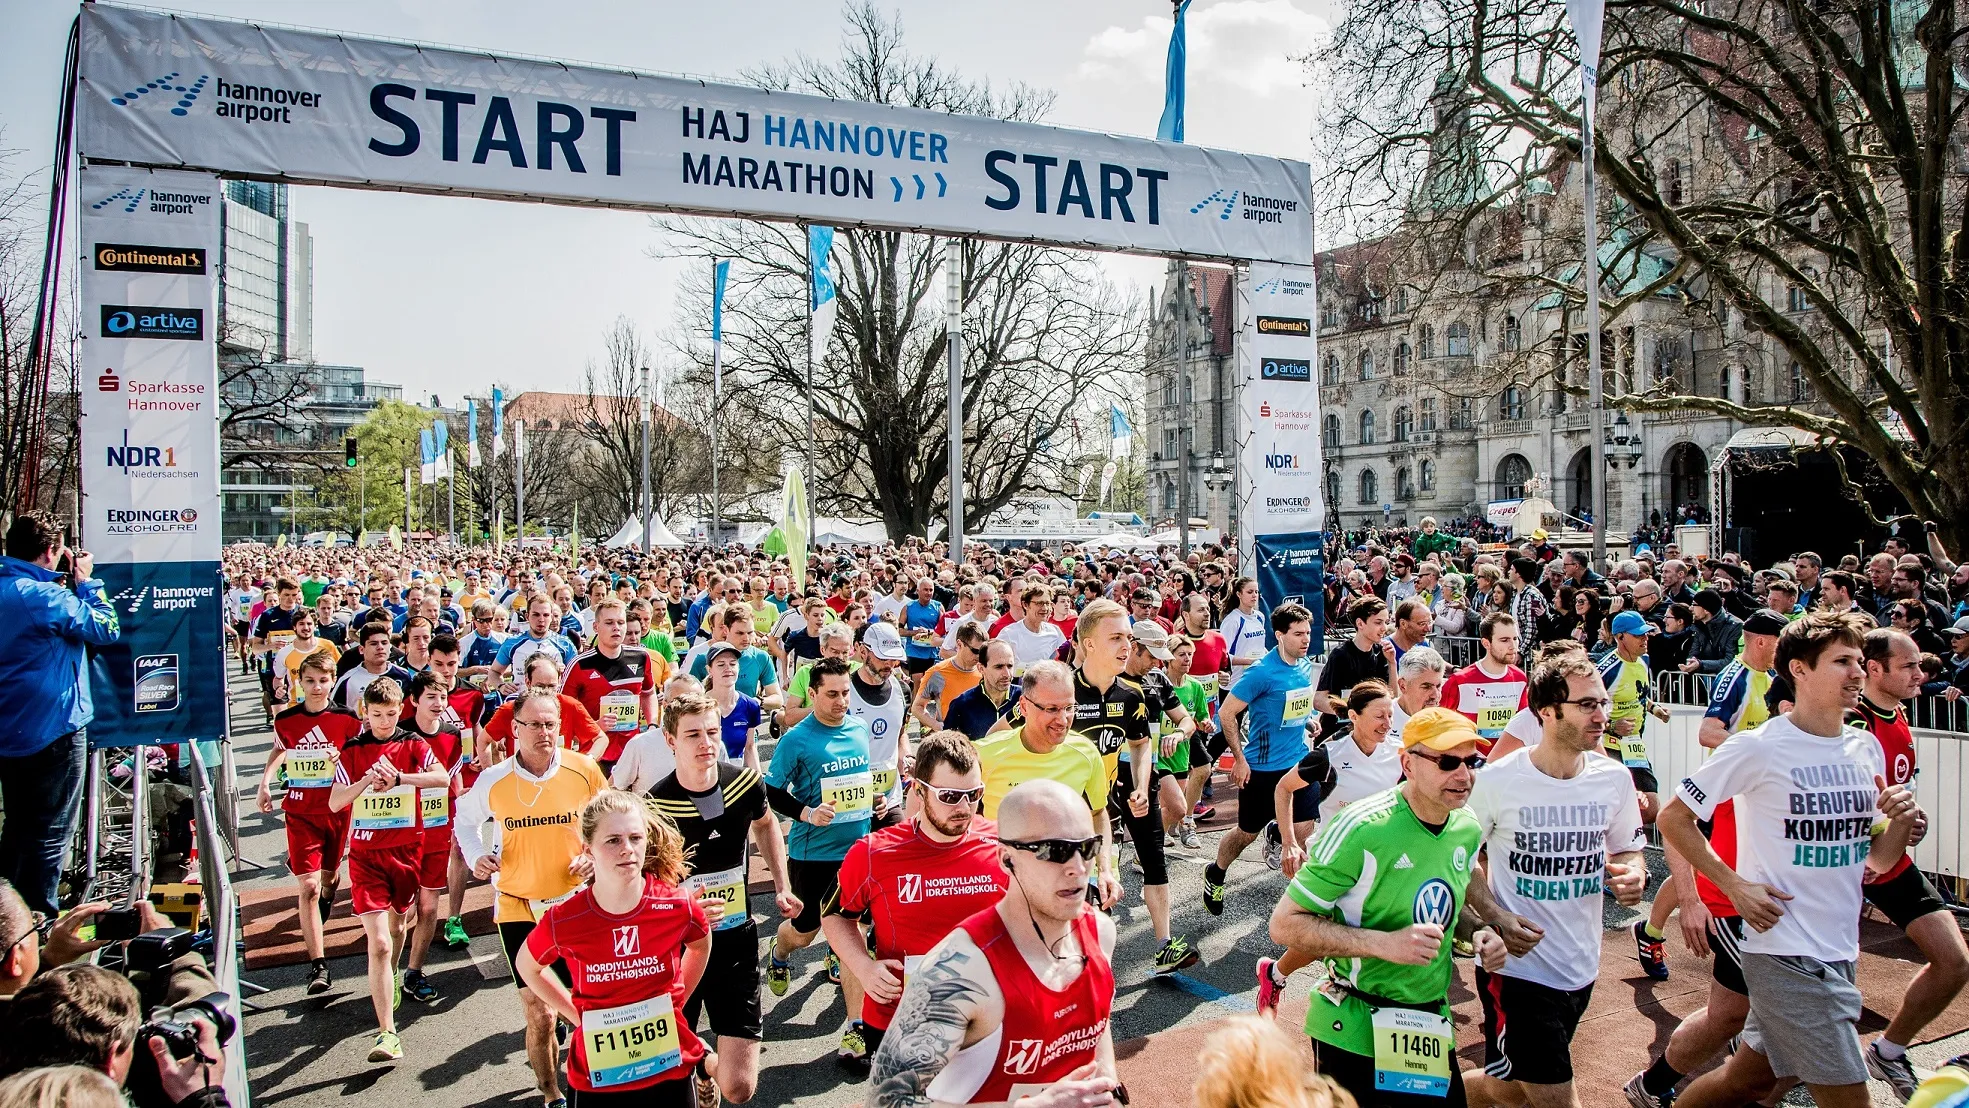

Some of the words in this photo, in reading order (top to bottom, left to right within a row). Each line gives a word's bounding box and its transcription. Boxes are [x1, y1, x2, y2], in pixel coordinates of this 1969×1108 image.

[216, 78, 321, 108] hannover
[216, 101, 290, 125] airport
[368, 82, 637, 177] START
[682, 106, 749, 144] HAJ
[764, 114, 948, 164] HANNOVER
[682, 152, 874, 200] MARATHON
[984, 149, 1169, 226] START
[150, 189, 211, 205] hannover
[1243, 191, 1298, 213] hannover
[150, 201, 193, 215] airport
[1243, 208, 1282, 225] airport
[99, 249, 187, 267] Continental
[1282, 279, 1312, 289] hannover
[1282, 287, 1304, 295] airport
[139, 313, 198, 329] artiva
[1259, 319, 1302, 331] Continental
[1279, 363, 1308, 374] artiva
[128, 380, 205, 396] Sparkasse
[128, 399, 201, 411] Hannover
[1274, 408, 1312, 418] Sparkasse
[1274, 422, 1310, 430] Hannover
[107, 446, 162, 467] NDR
[165, 446, 177, 467] 1
[1265, 454, 1292, 469] NDR
[1293, 454, 1299, 469] 1
[131, 470, 199, 478] Niedersachsen
[1266, 497, 1303, 507] ERDINGER
[107, 509, 180, 523] ERDINGER
[107, 524, 197, 532] ALKOHOLFREI
[1289, 549, 1319, 557] hannover
[1290, 556, 1311, 566] airport
[153, 586, 214, 598] hannover
[153, 598, 196, 612] airport
[138, 658, 169, 667] IAAF
[140, 691, 168, 699] SILVER
[1486, 709, 1512, 721] 10840
[295, 741, 335, 750] adidas
[294, 760, 326, 772] 11782
[821, 754, 869, 774] talanx.
[363, 797, 401, 809] 11783
[1788, 790, 1877, 815] BERUFUN
[504, 812, 572, 831] Continental
[354, 830, 374, 841] LW
[1792, 843, 1850, 868] JEDEN
[925, 874, 992, 888] NORDJYLLANDS
[925, 883, 998, 897] IDRÆTSHØJSKOLE
[1516, 876, 1570, 901] JEDEN
[586, 955, 659, 973] NORDJYLLANDS
[586, 963, 666, 983] IDRÆTSHØJSKOLE
[615, 1004, 649, 1017] HANNOVER
[604, 1014, 637, 1025] MARATHON
[1395, 1020, 1424, 1029] MARATHON
[593, 1018, 669, 1053] F11569
[1390, 1032, 1440, 1059] 11460
[628, 1049, 642, 1060] Mie
[1404, 1059, 1428, 1072] Henning
[594, 1071, 603, 1082] B
[1378, 1072, 1385, 1084] B
